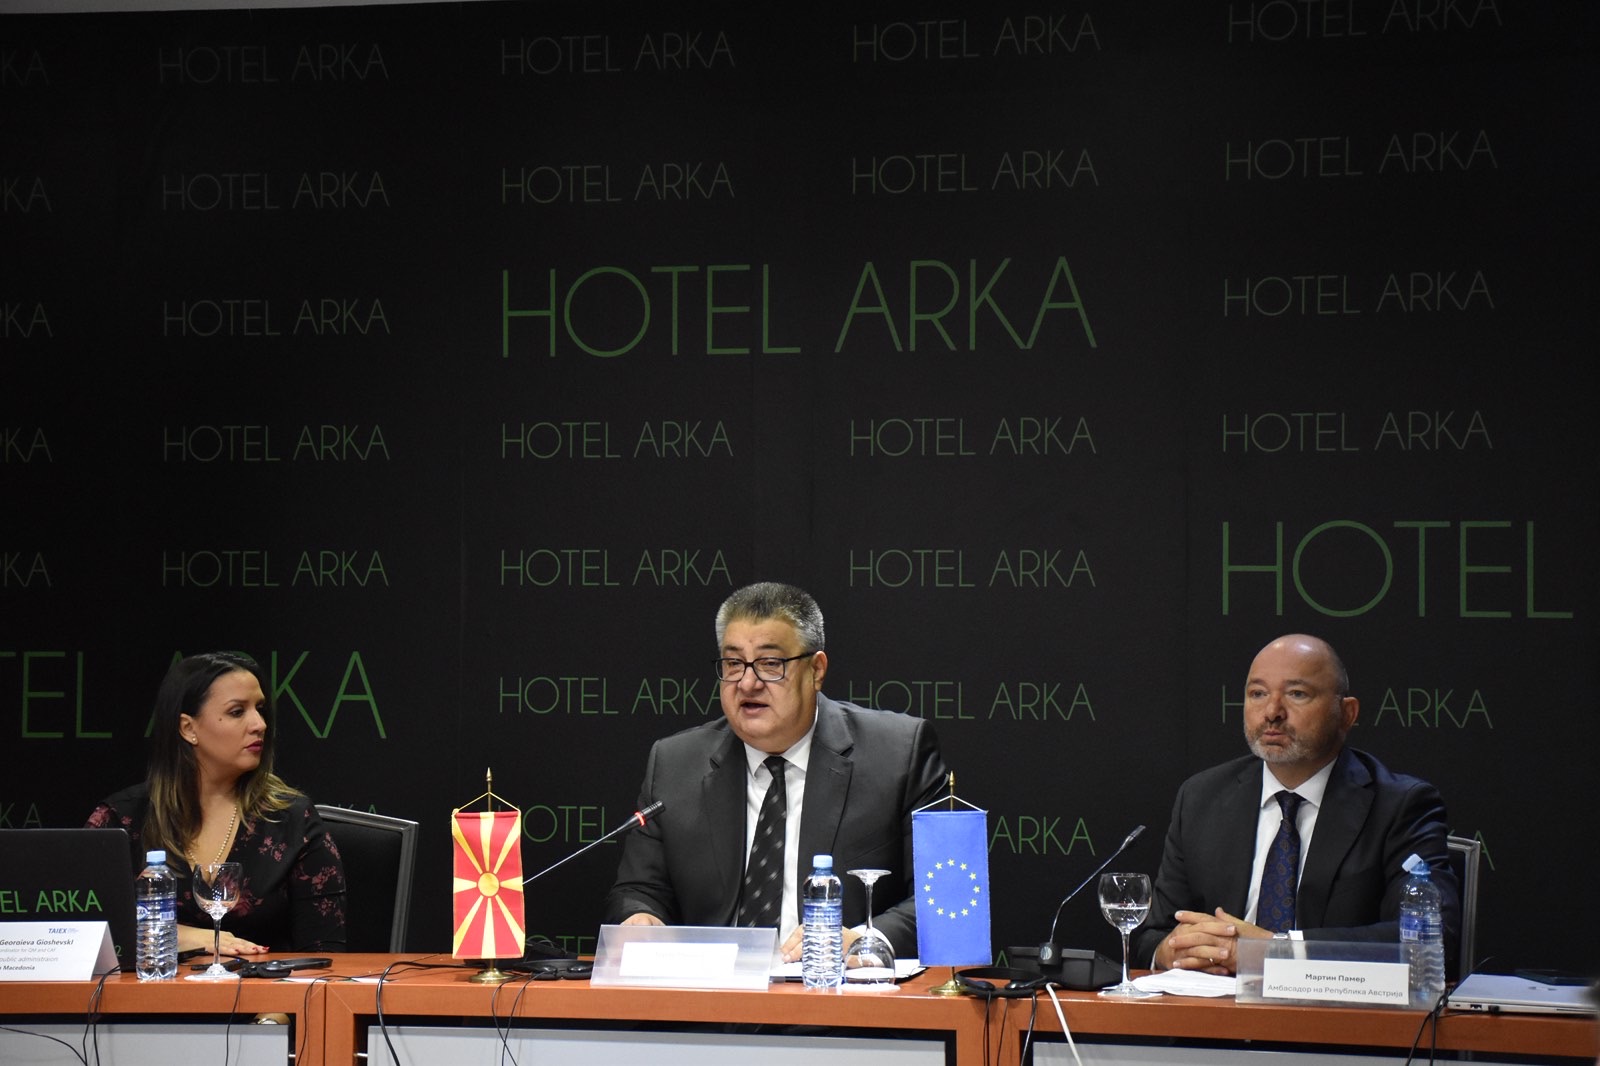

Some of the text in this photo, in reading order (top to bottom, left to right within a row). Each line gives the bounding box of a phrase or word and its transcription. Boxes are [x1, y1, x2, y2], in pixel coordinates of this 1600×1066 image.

[853, 13, 1101, 62] HOTEL ARKA
[1228, 0, 1502, 43] HOTEL ARKA
[159, 44, 389, 84] HOTEL ARKA
[502, 31, 735, 74] HOTEL ARKA
[853, 149, 1099, 194] HOTEL ARKA
[1225, 130, 1498, 181] HOTEL ARKA
[163, 171, 390, 211] HOTEL ARKA
[502, 162, 734, 203] HOTEL ARKA
[503, 257, 1097, 357] HOTEL ARKA
[1224, 271, 1494, 317] HOTEL ARKA
[0, 303, 53, 338] KA
[164, 299, 390, 336] HOTEL ARKA
[0, 427, 53, 464] KA
[164, 425, 390, 462] HOTEL ARKA
[502, 421, 733, 459] HOTEL ARKA
[851, 417, 1096, 456] HOTEL ARKA
[1223, 411, 1492, 452] HOTEL ARKA
[0, 552, 51, 588] KA
[163, 551, 389, 587] HOTEL ARKA
[501, 549, 732, 586] HOTEL ARKA
[850, 549, 1095, 587] HOTEL ARKA
[1222, 520, 1572, 618] HOTEL
[500, 677, 619, 714] HOTEL
[849, 680, 1095, 721] HOTEL ARKA
[1374, 688, 1493, 728] ARKA
[989, 815, 1095, 856] ARKA
[36, 890, 103, 913] ARKA
[1267, 985, 1312, 993] Амбасадор
[1324, 987, 1367, 996] Република
[1367, 989, 1403, 998] Австрија
[1338, 975, 1366, 983] Памер
